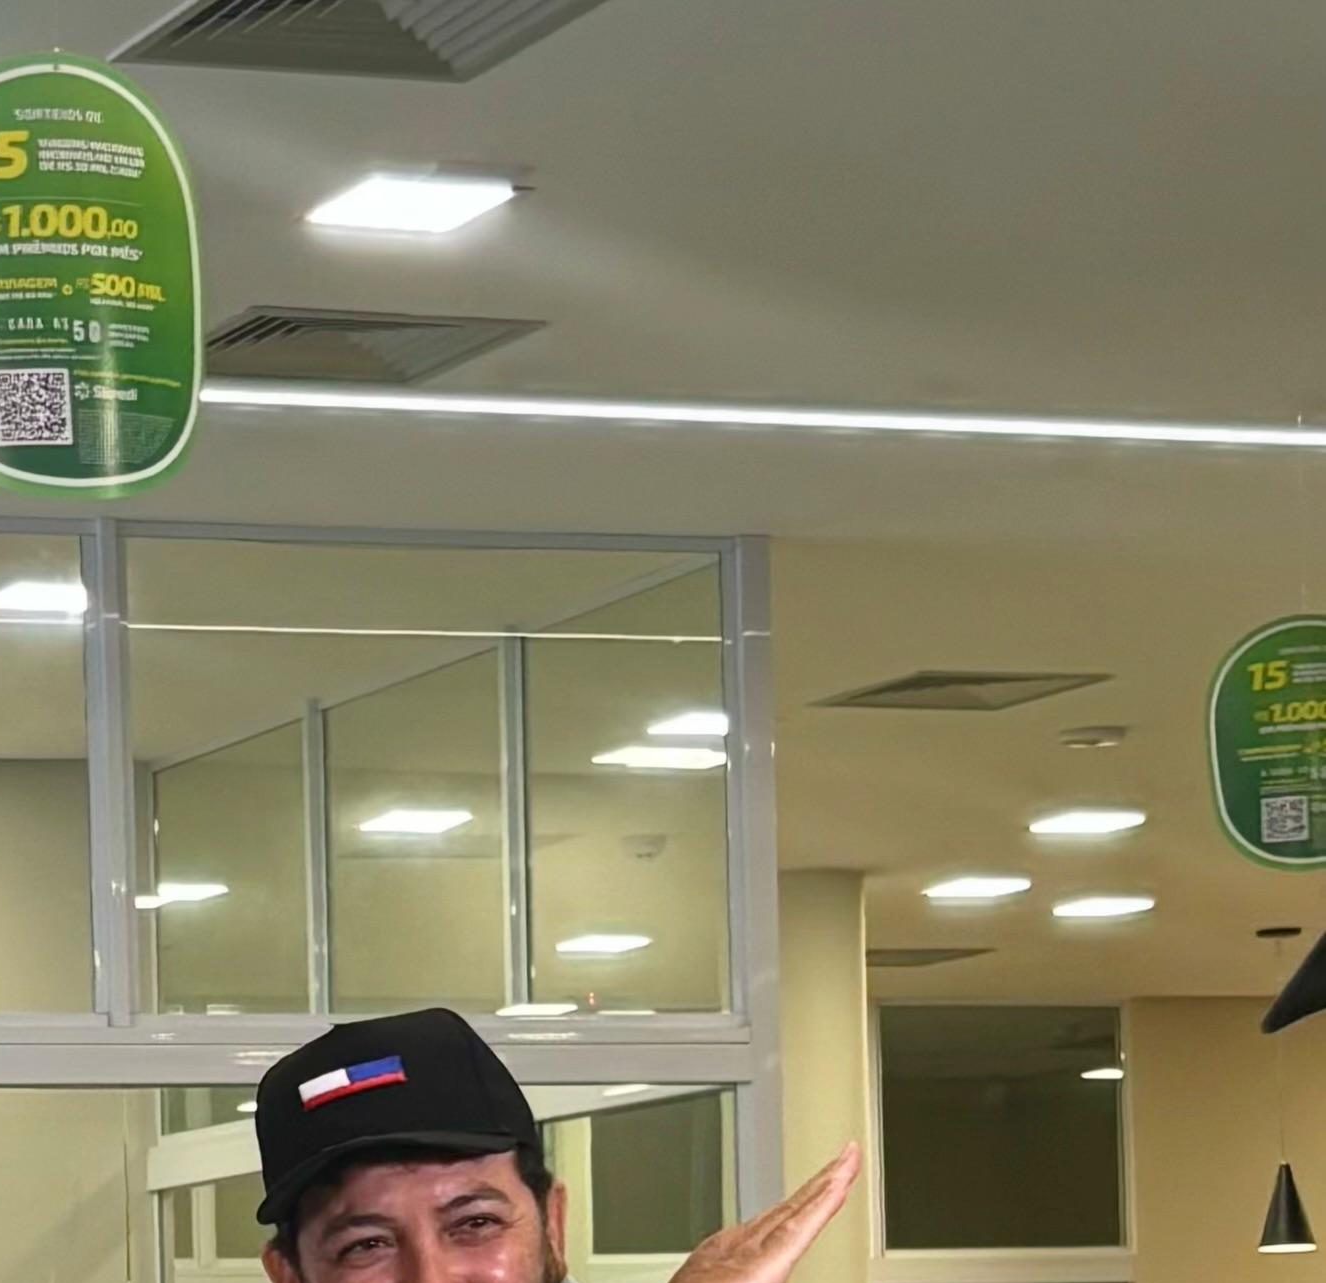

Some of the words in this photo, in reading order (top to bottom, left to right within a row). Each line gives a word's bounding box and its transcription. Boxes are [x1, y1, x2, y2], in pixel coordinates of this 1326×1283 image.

[2, 203, 138, 240] 1.000,00
[90, 272, 136, 297] 500
[1248, 660, 1289, 691] 15
